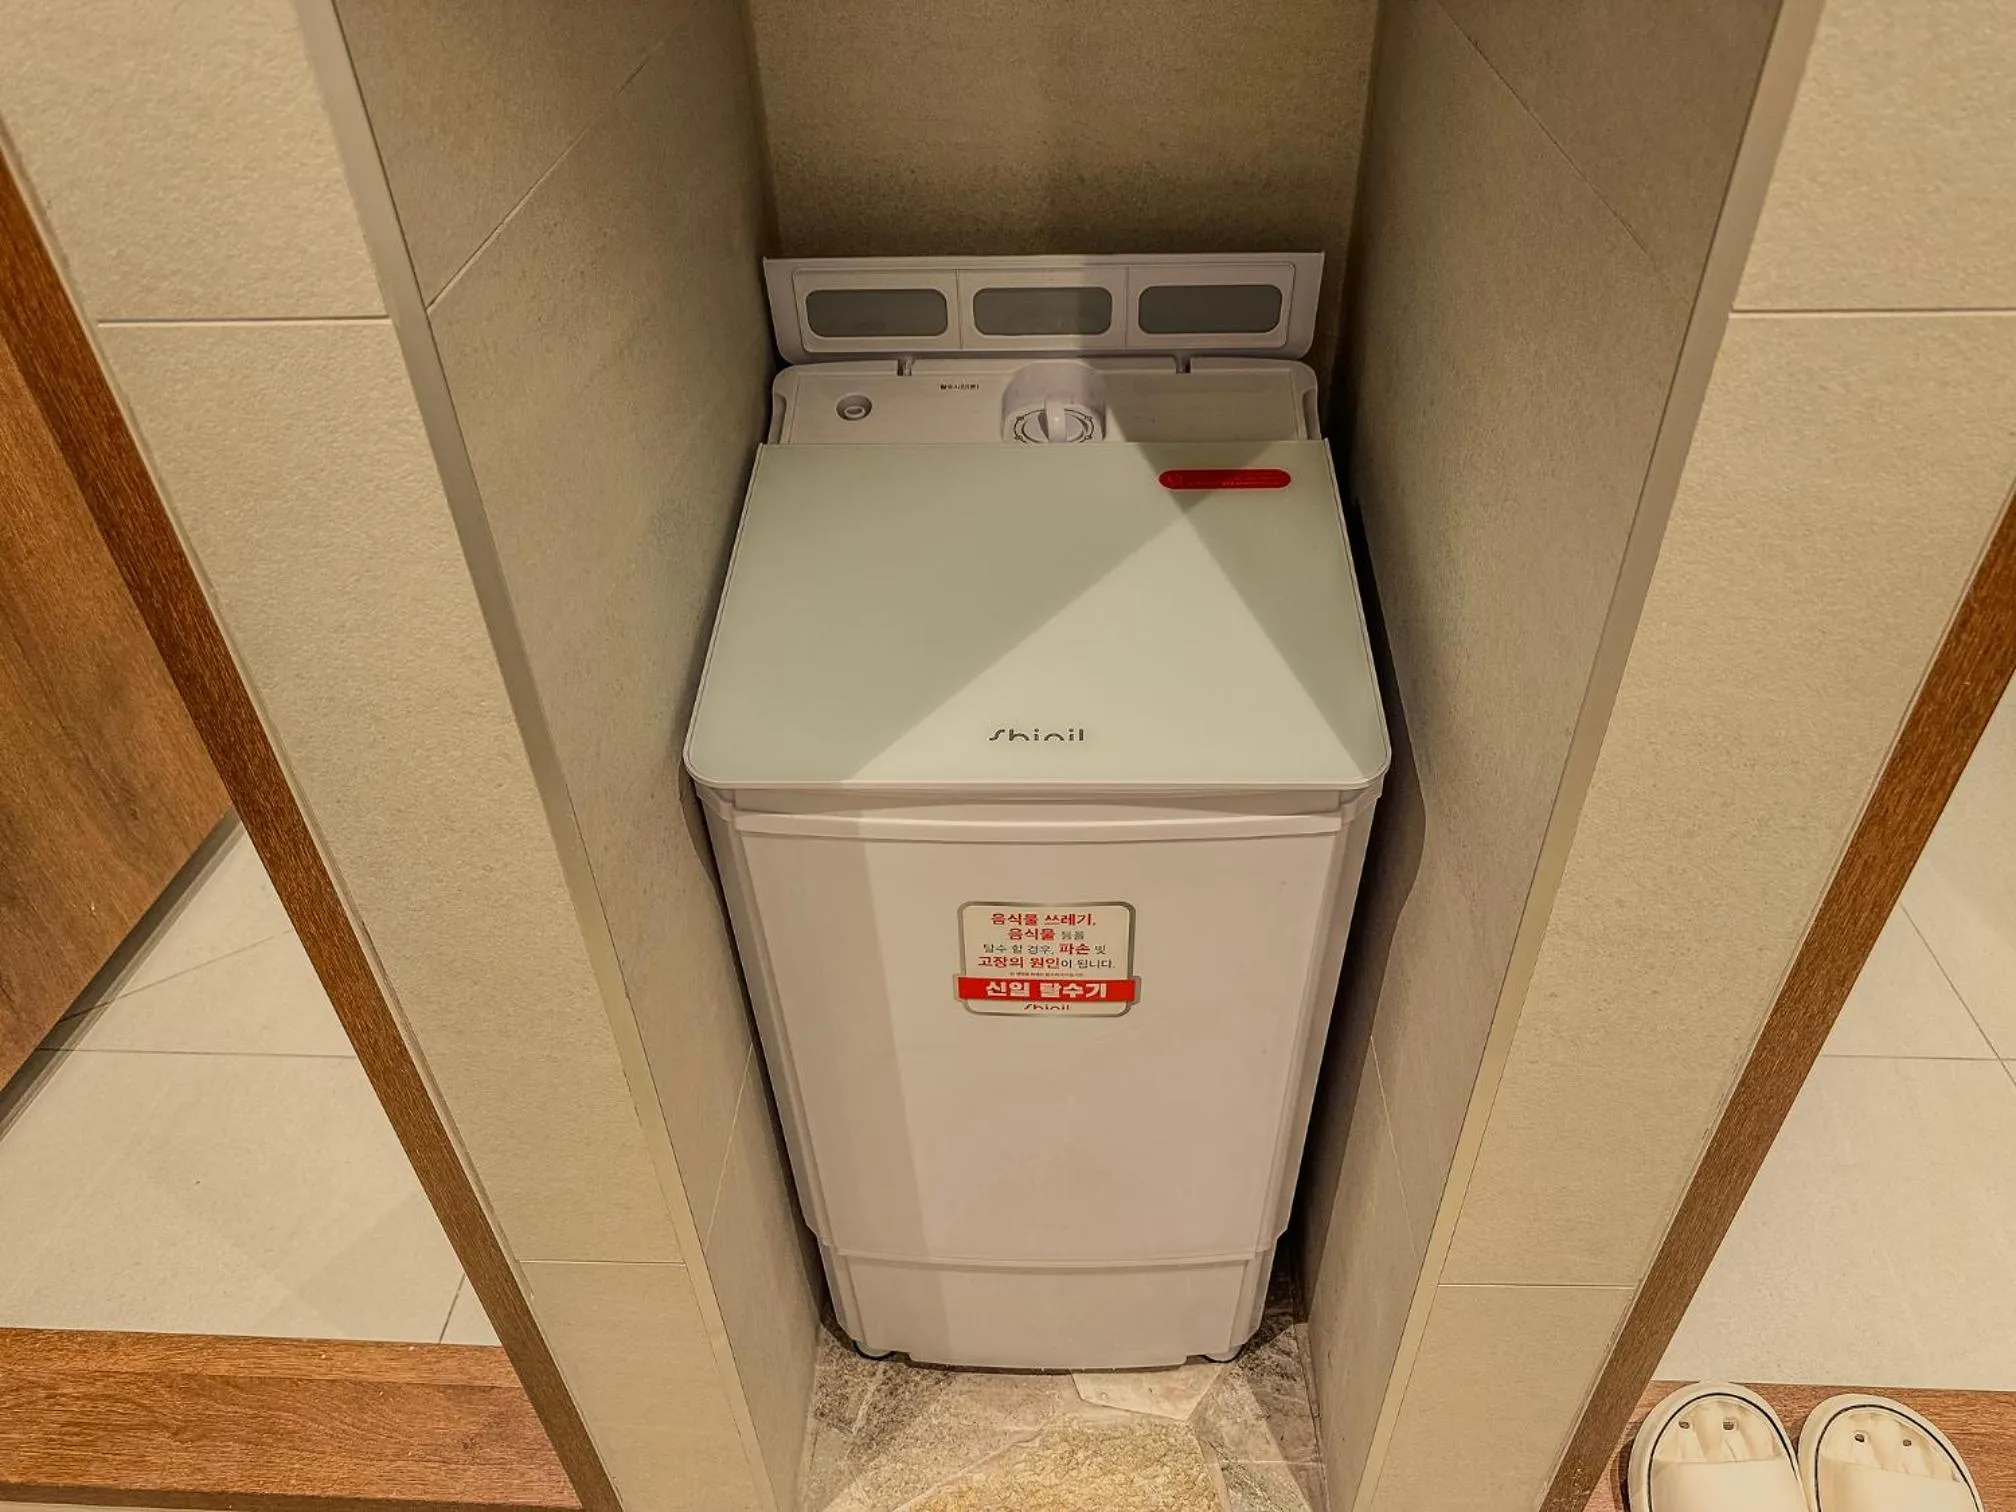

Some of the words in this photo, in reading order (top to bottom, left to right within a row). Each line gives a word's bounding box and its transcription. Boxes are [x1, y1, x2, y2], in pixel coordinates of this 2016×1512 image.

[992, 913, 1039, 926] 음식물
[1008, 928, 1055, 941] 음식물
[1059, 942, 1091, 955] 파손
[977, 956, 1024, 969] 고장의
[1030, 956, 1072, 969] 원인이
[1077, 959, 1116, 969] 됩니다.
[986, 981, 1030, 998] 신일
[1040, 982, 1108, 999] 탈수기
